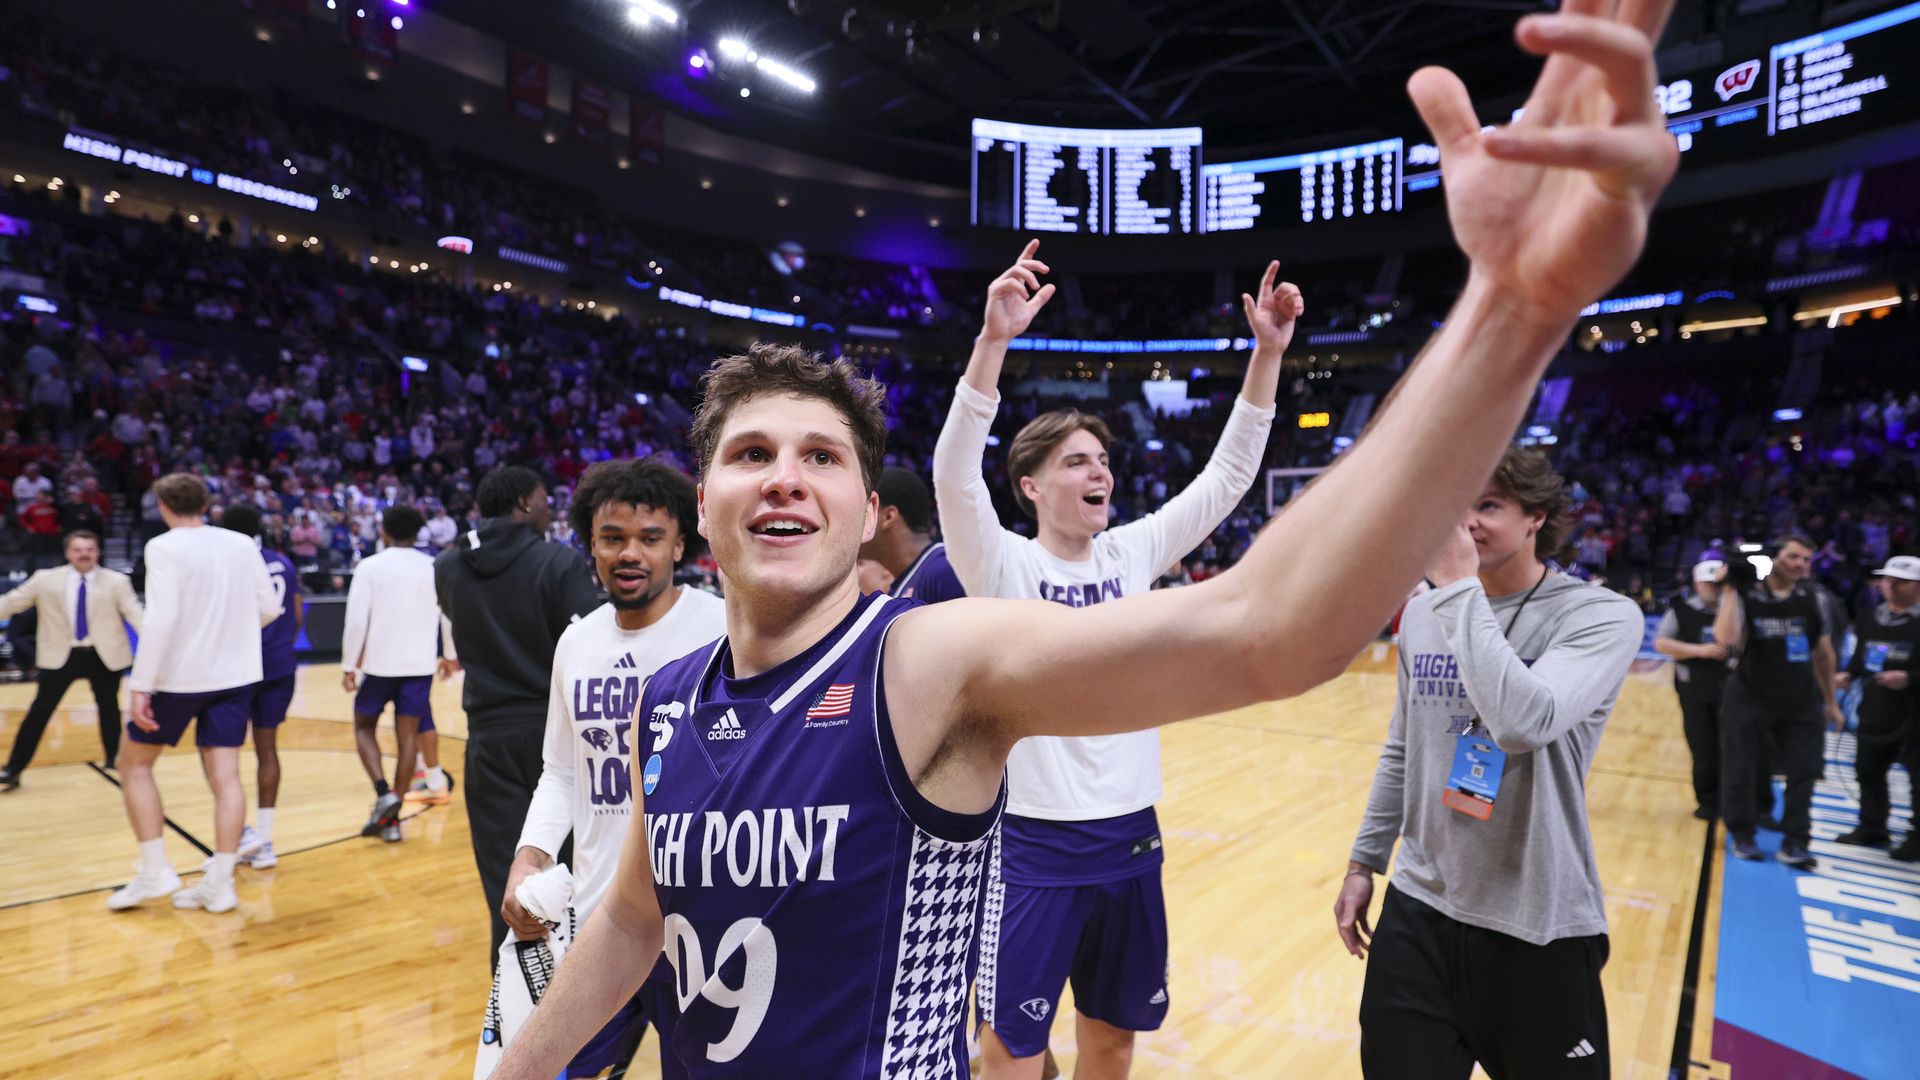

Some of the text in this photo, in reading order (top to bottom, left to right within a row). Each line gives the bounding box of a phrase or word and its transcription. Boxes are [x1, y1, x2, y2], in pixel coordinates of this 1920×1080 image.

[1413, 654, 1458, 679] HIGH
[574, 675, 648, 721] LEGA
[707, 727, 747, 741] adidas
[644, 805, 850, 888] IGH POINT
